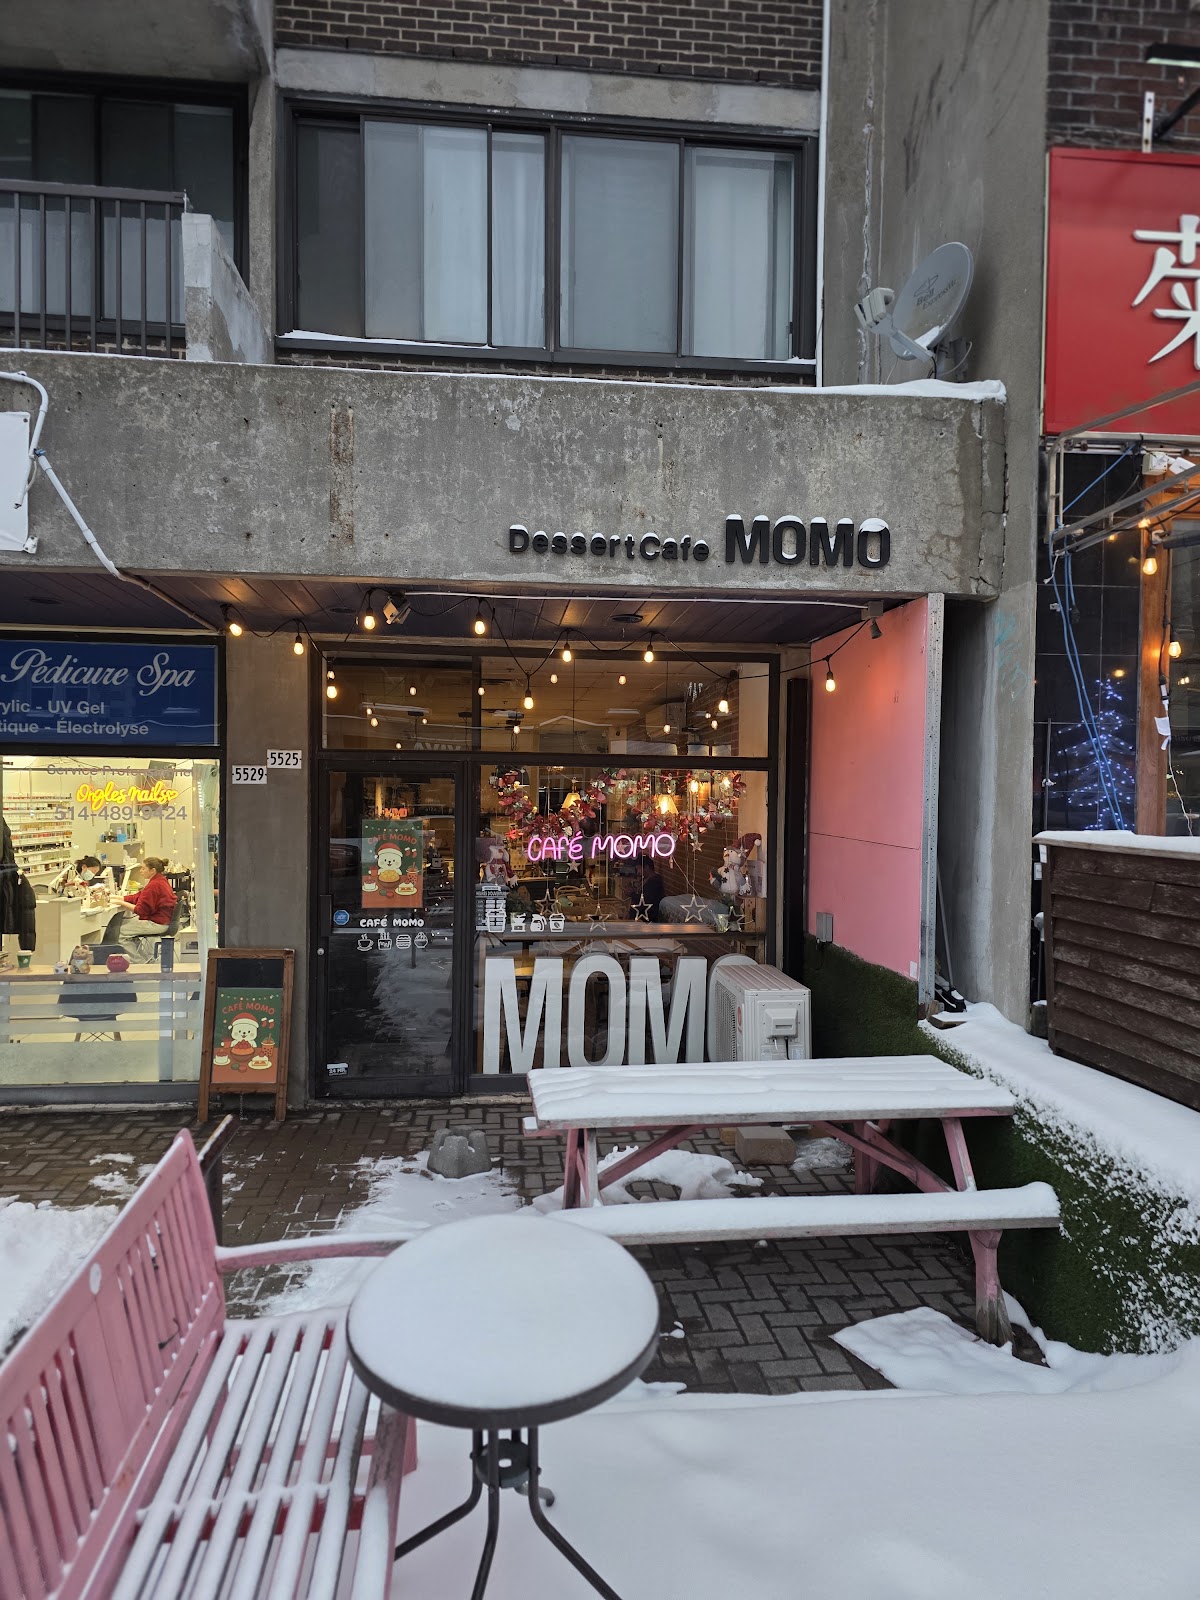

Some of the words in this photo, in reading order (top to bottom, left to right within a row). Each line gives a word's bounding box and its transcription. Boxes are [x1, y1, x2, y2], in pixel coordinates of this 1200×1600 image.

[725, 513, 891, 568] MOMO
[0, 648, 129, 686] Pédicure
[136, 652, 196, 696] Spa
[48, 700, 72, 714] UV
[77, 701, 105, 714] Gel
[56, 717, 149, 737] Électrolyse
[270, 752, 299, 766] 5525
[47, 764, 98, 776] Service
[235, 767, 264, 781] 5529
[128, 780, 170, 805] nails
[54, 805, 187, 821] 514-489-9424
[390, 833, 417, 845] MOMO
[591, 833, 676, 859] MOMO
[360, 914, 388, 927] CAFÉ
[392, 918, 425, 927] MOMO
[221, 1000, 243, 1014] CAFÉ
[246, 1002, 275, 1015] MOMO
